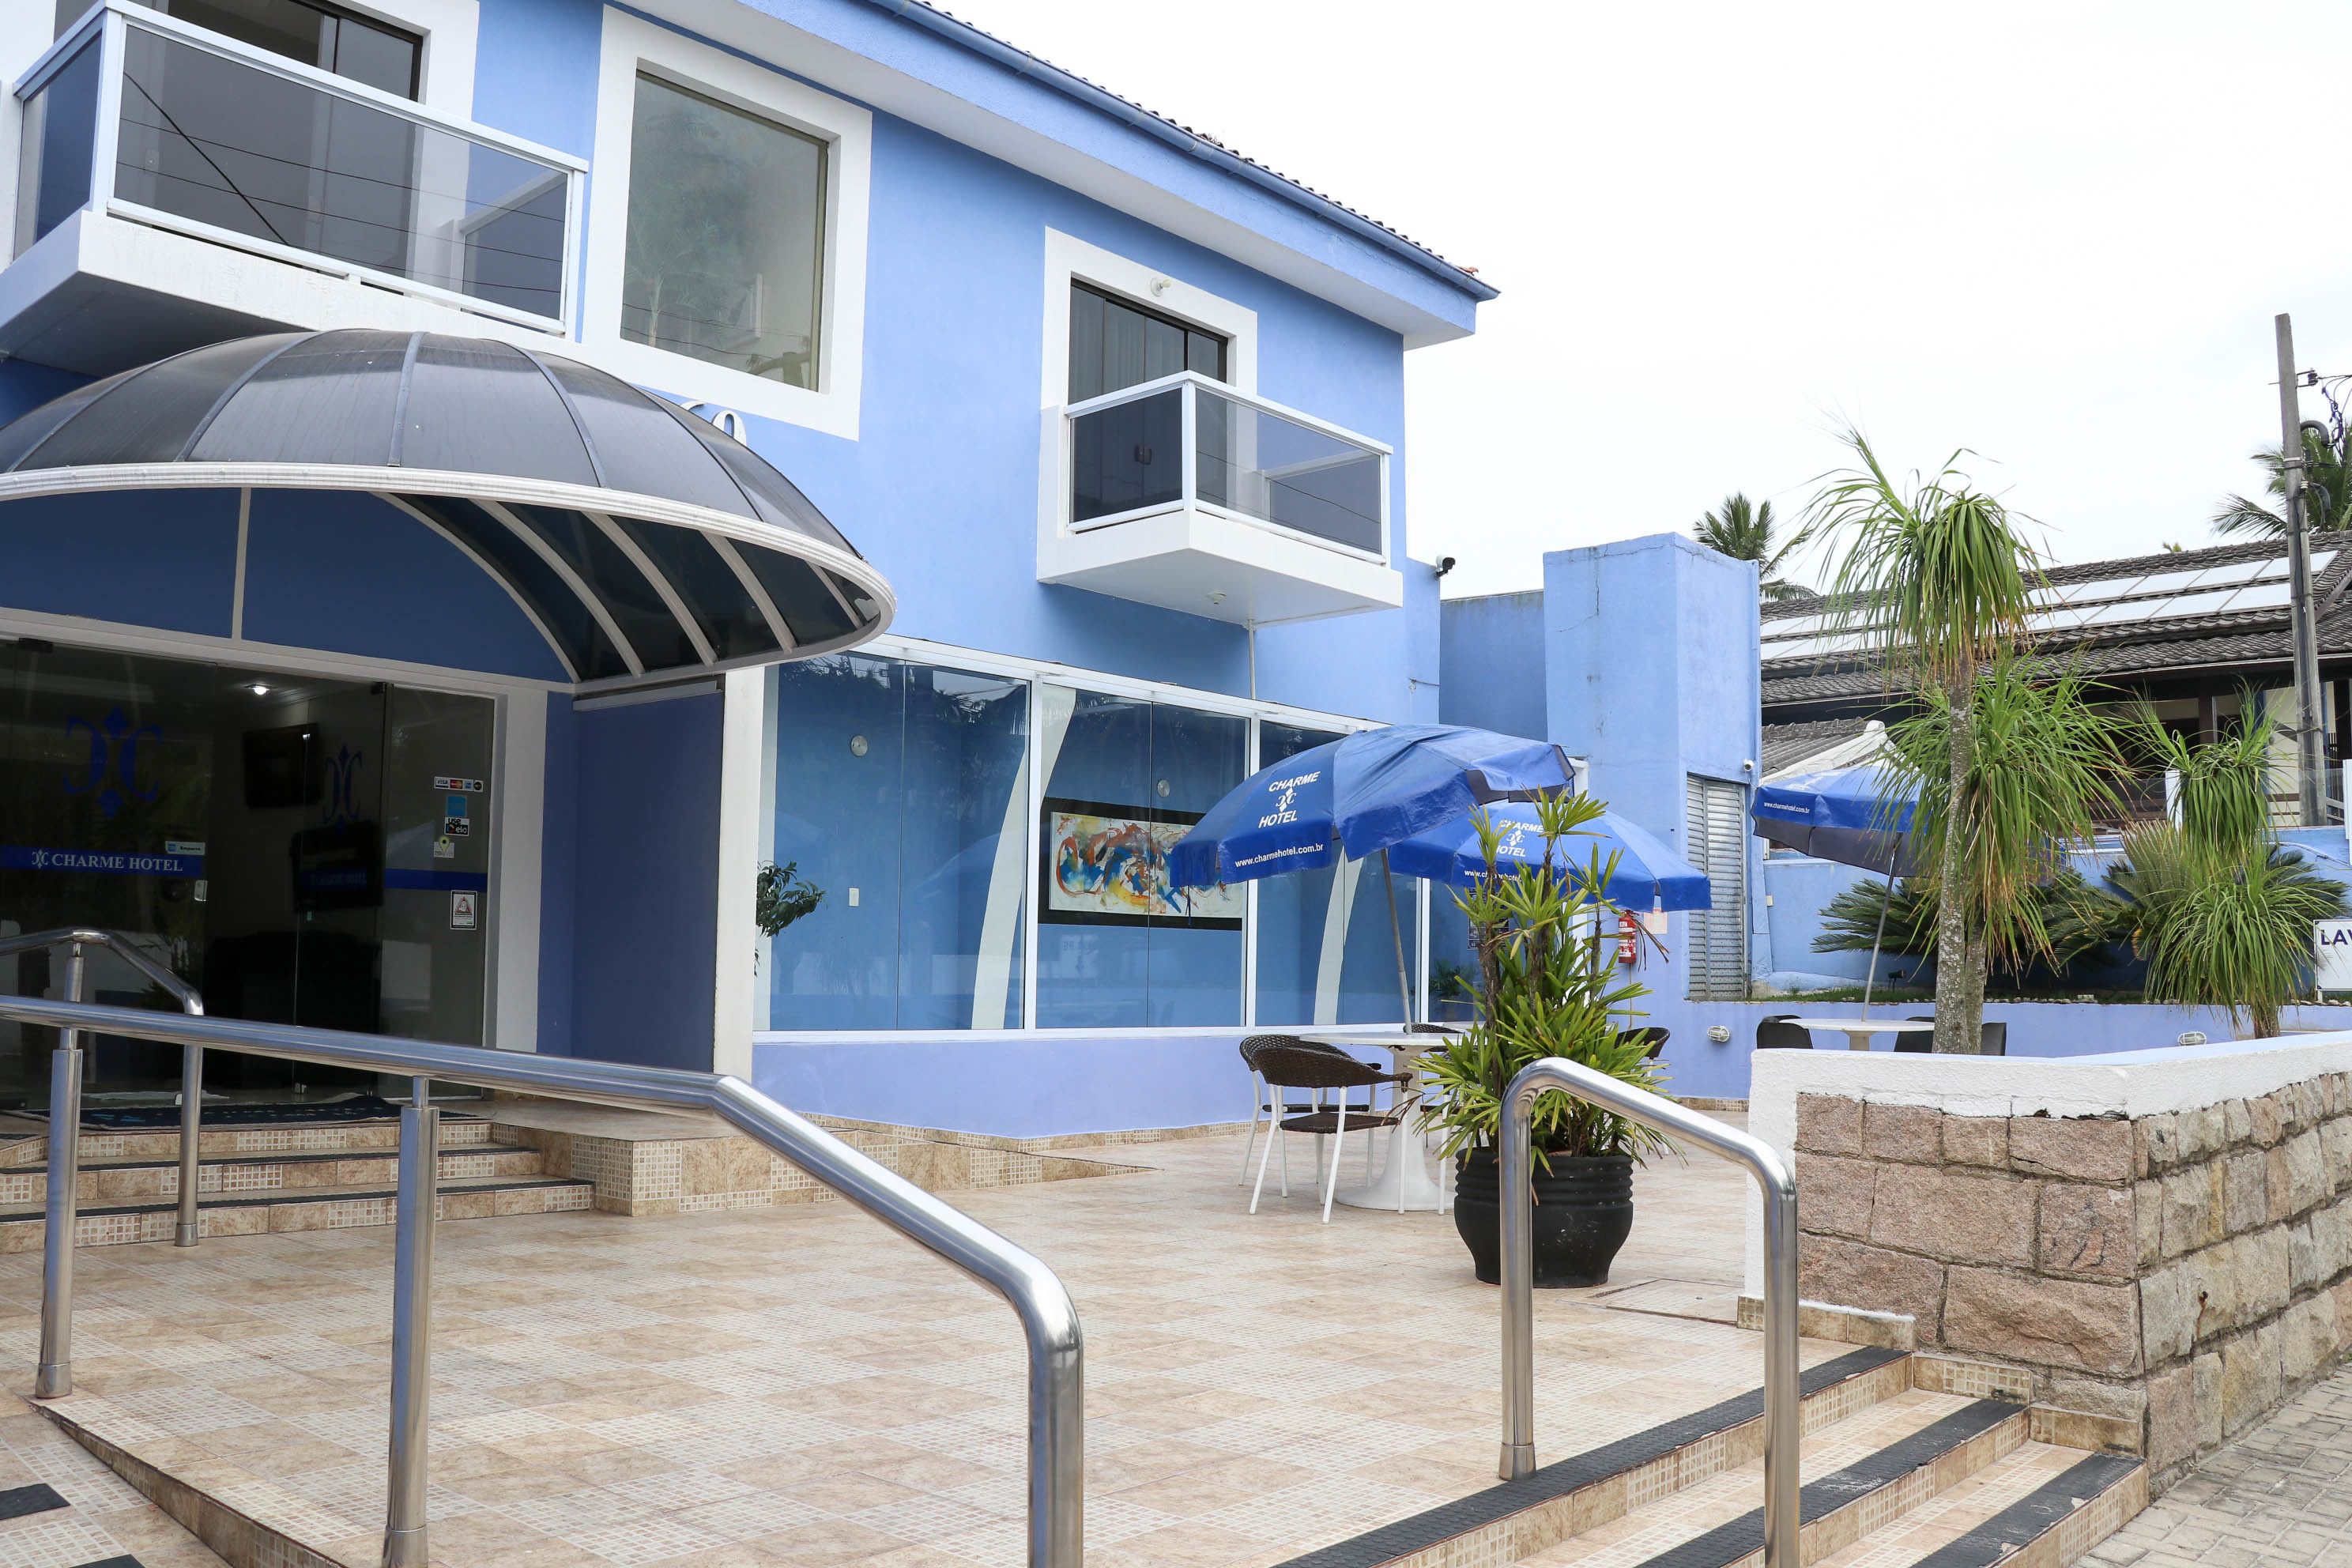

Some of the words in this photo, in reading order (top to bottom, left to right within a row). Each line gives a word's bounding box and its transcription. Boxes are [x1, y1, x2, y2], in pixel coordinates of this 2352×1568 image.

[1268, 771, 1321, 792] CHARME
[1763, 801, 1810, 814] www.charmehotel.com.br
[1258, 809, 1298, 828] HOTEL
[51, 854, 124, 869] CHARME
[129, 858, 183, 872] HOTEL
[1235, 843, 1324, 868] www.charmehotel.com.br
